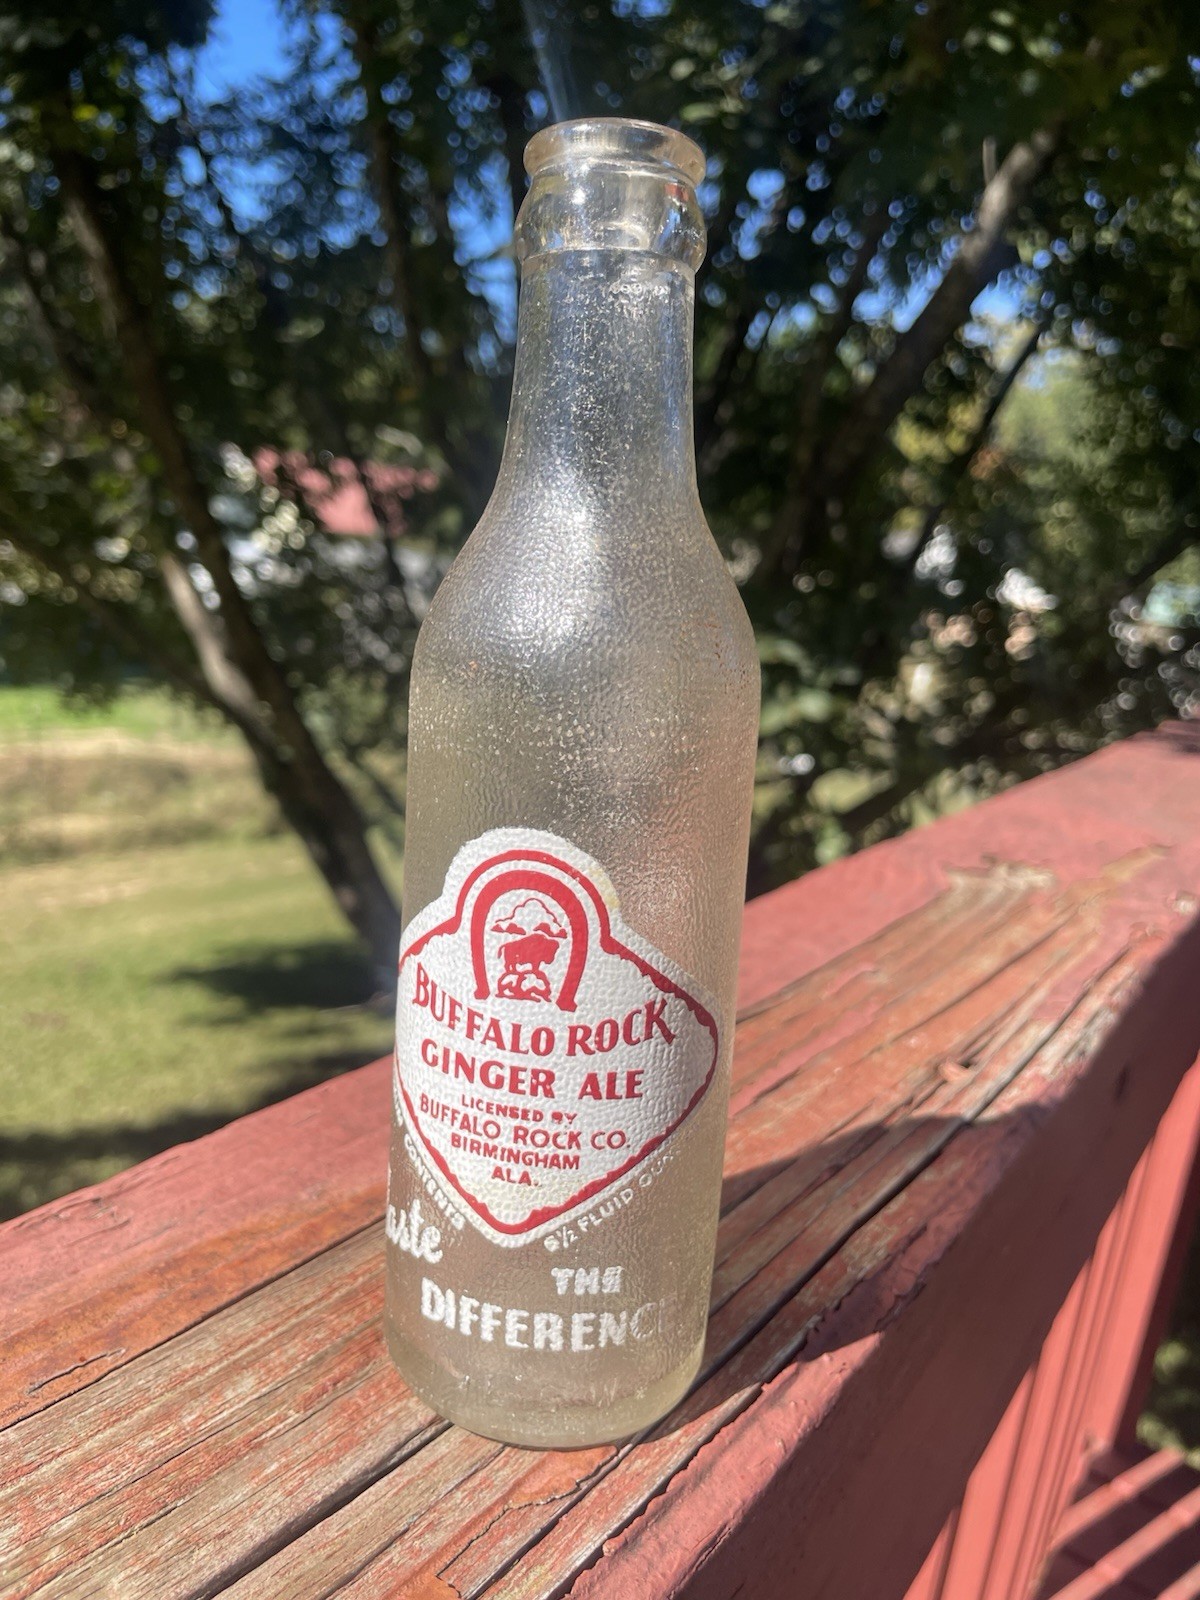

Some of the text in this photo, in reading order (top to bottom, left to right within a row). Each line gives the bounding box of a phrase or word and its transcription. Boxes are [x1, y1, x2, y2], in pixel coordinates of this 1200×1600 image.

[413, 962, 677, 1056] BUFFALO ROCK
[420, 1038, 645, 1100] GINGER ALE
[419, 1093, 502, 1140] BUFFALO
[512, 1126, 582, 1151] ROCK
[590, 1130, 632, 1150] CO.
[461, 1094, 545, 1121] LICENSED
[450, 1134, 580, 1170] BIRMINGHAM
[491, 1166, 543, 1187] ALA.
[578, 1187, 635, 1233] FLUID
[551, 1265, 622, 1296] THE
